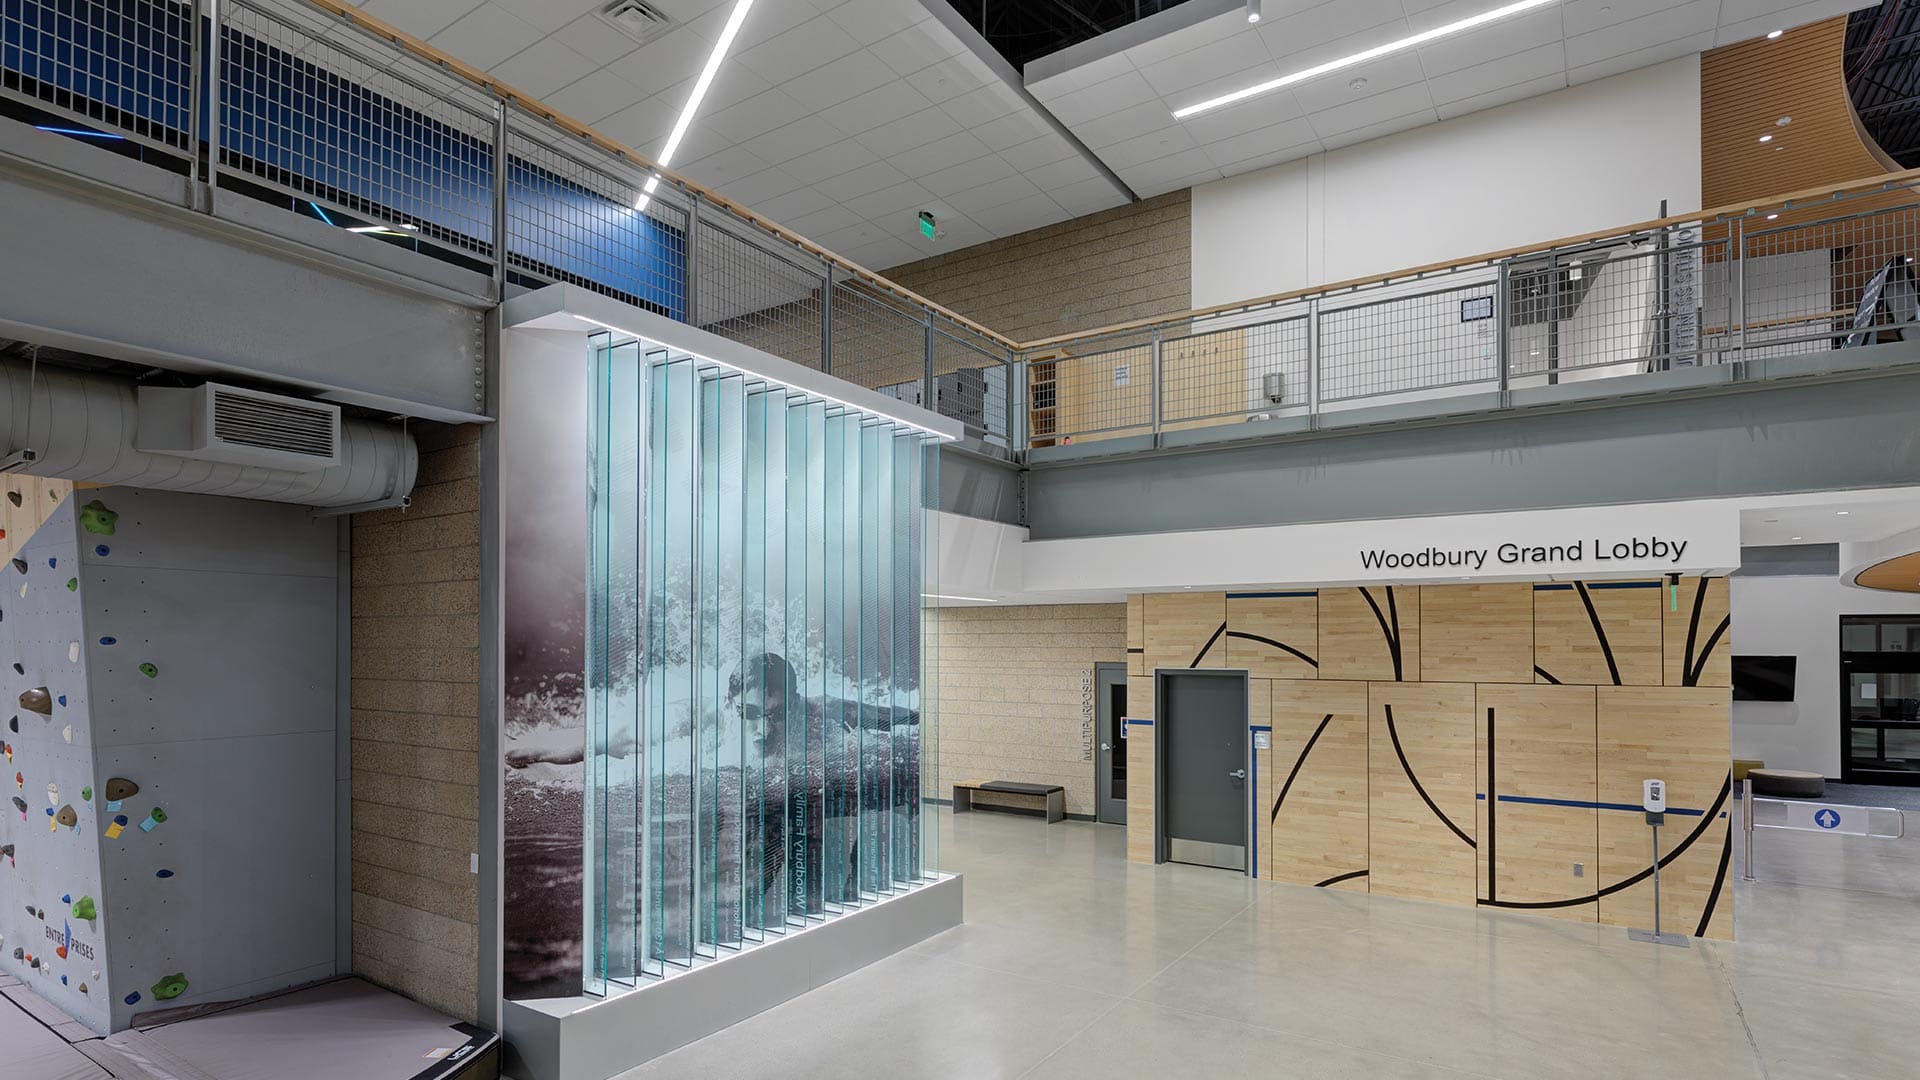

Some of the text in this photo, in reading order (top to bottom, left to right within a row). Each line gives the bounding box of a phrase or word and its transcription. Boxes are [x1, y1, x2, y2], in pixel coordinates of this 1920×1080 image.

[1360, 536, 1688, 570] Woodbury Grand Lobby
[1080, 668, 1092, 761] MULTIPURPOSE 2
[45, 925, 95, 961] ENTRE PRISES
